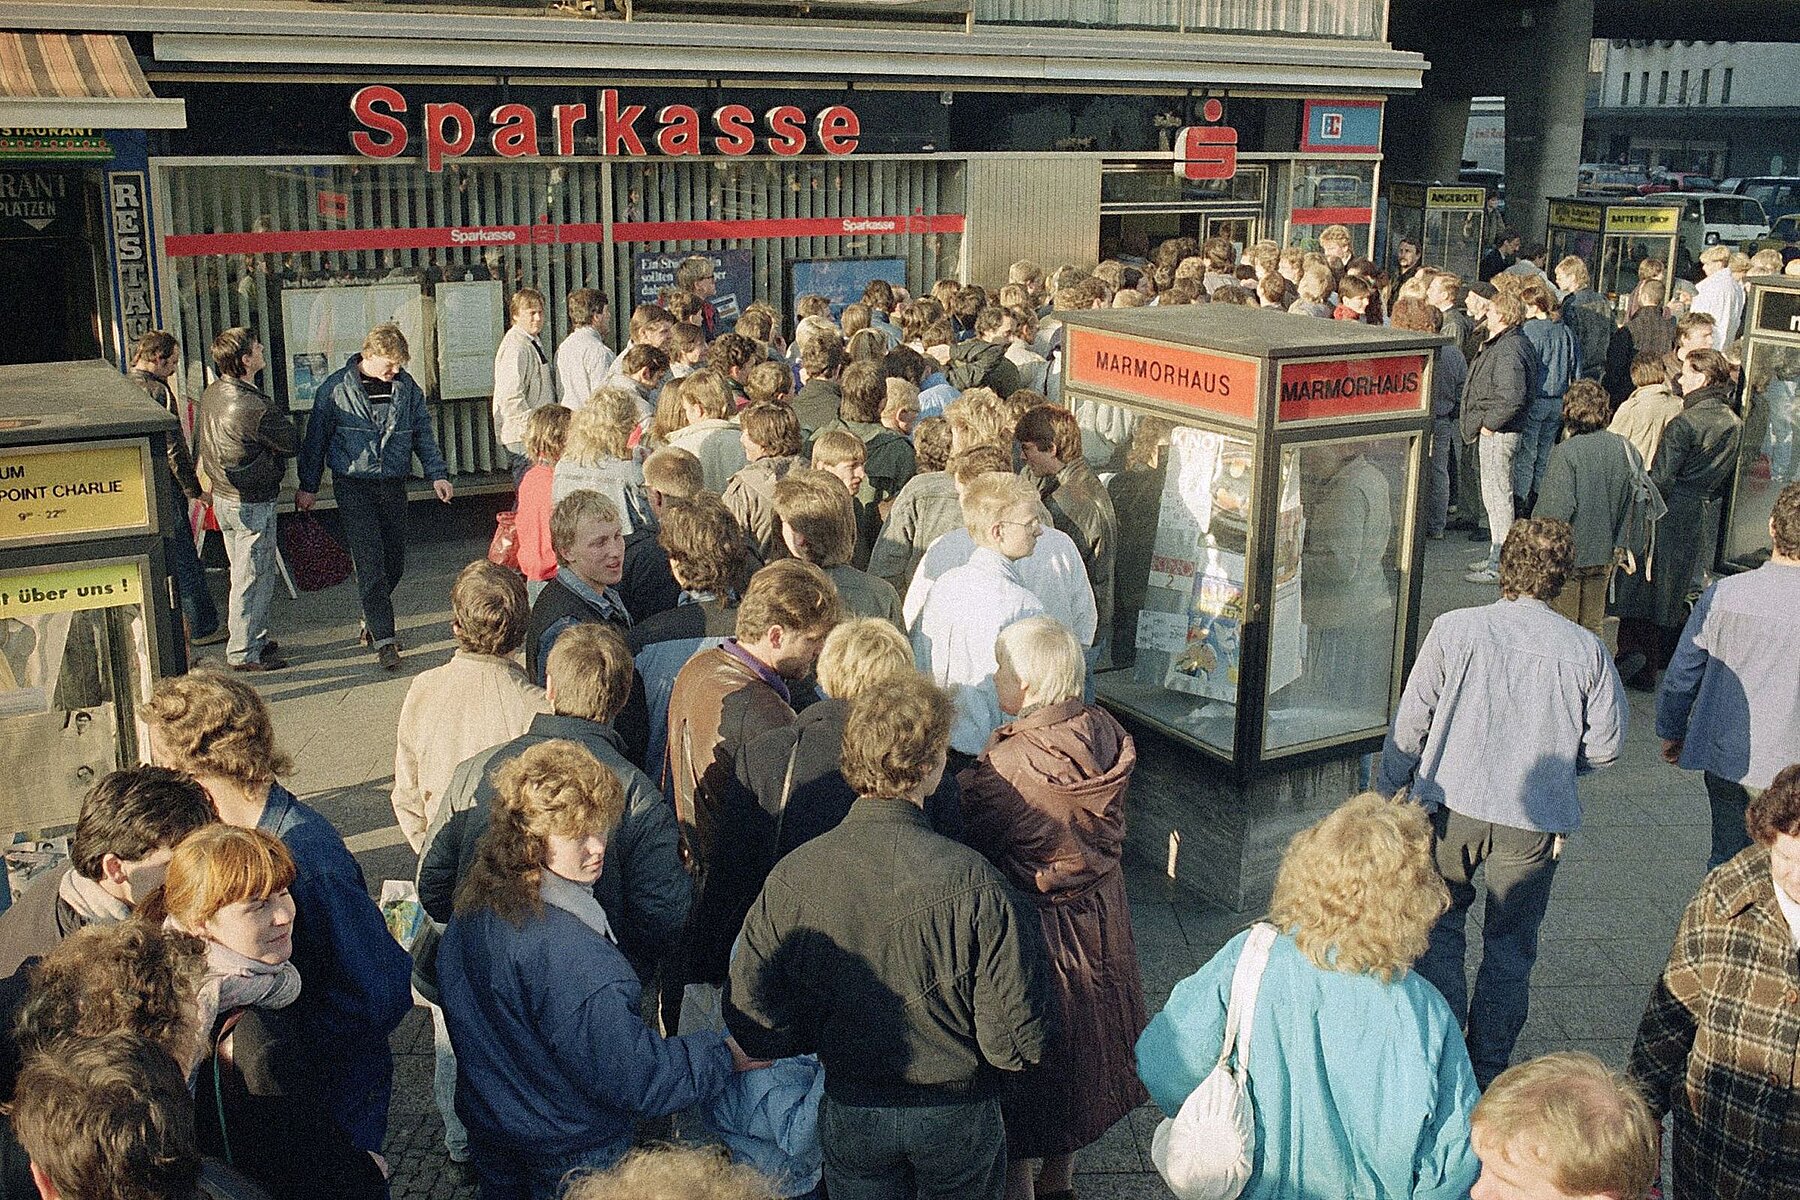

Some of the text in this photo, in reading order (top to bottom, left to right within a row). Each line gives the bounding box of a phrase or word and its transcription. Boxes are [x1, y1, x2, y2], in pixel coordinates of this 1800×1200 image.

[349, 85, 860, 172] Sparkasse
[1431, 193, 1479, 203] ANGEBOTE
[842, 219, 895, 232] Sparkasse
[451, 229, 516, 244] Sparkasse
[641, 271, 674, 282] sollten
[1095, 350, 1231, 397] MARMORHAUS
[1281, 371, 1418, 402] MARMORHAUS
[52, 480, 124, 498] CHARLIE
[1165, 574, 1175, 589] 2
[19, 588, 68, 603] über
[77, 584, 114, 597] uns
